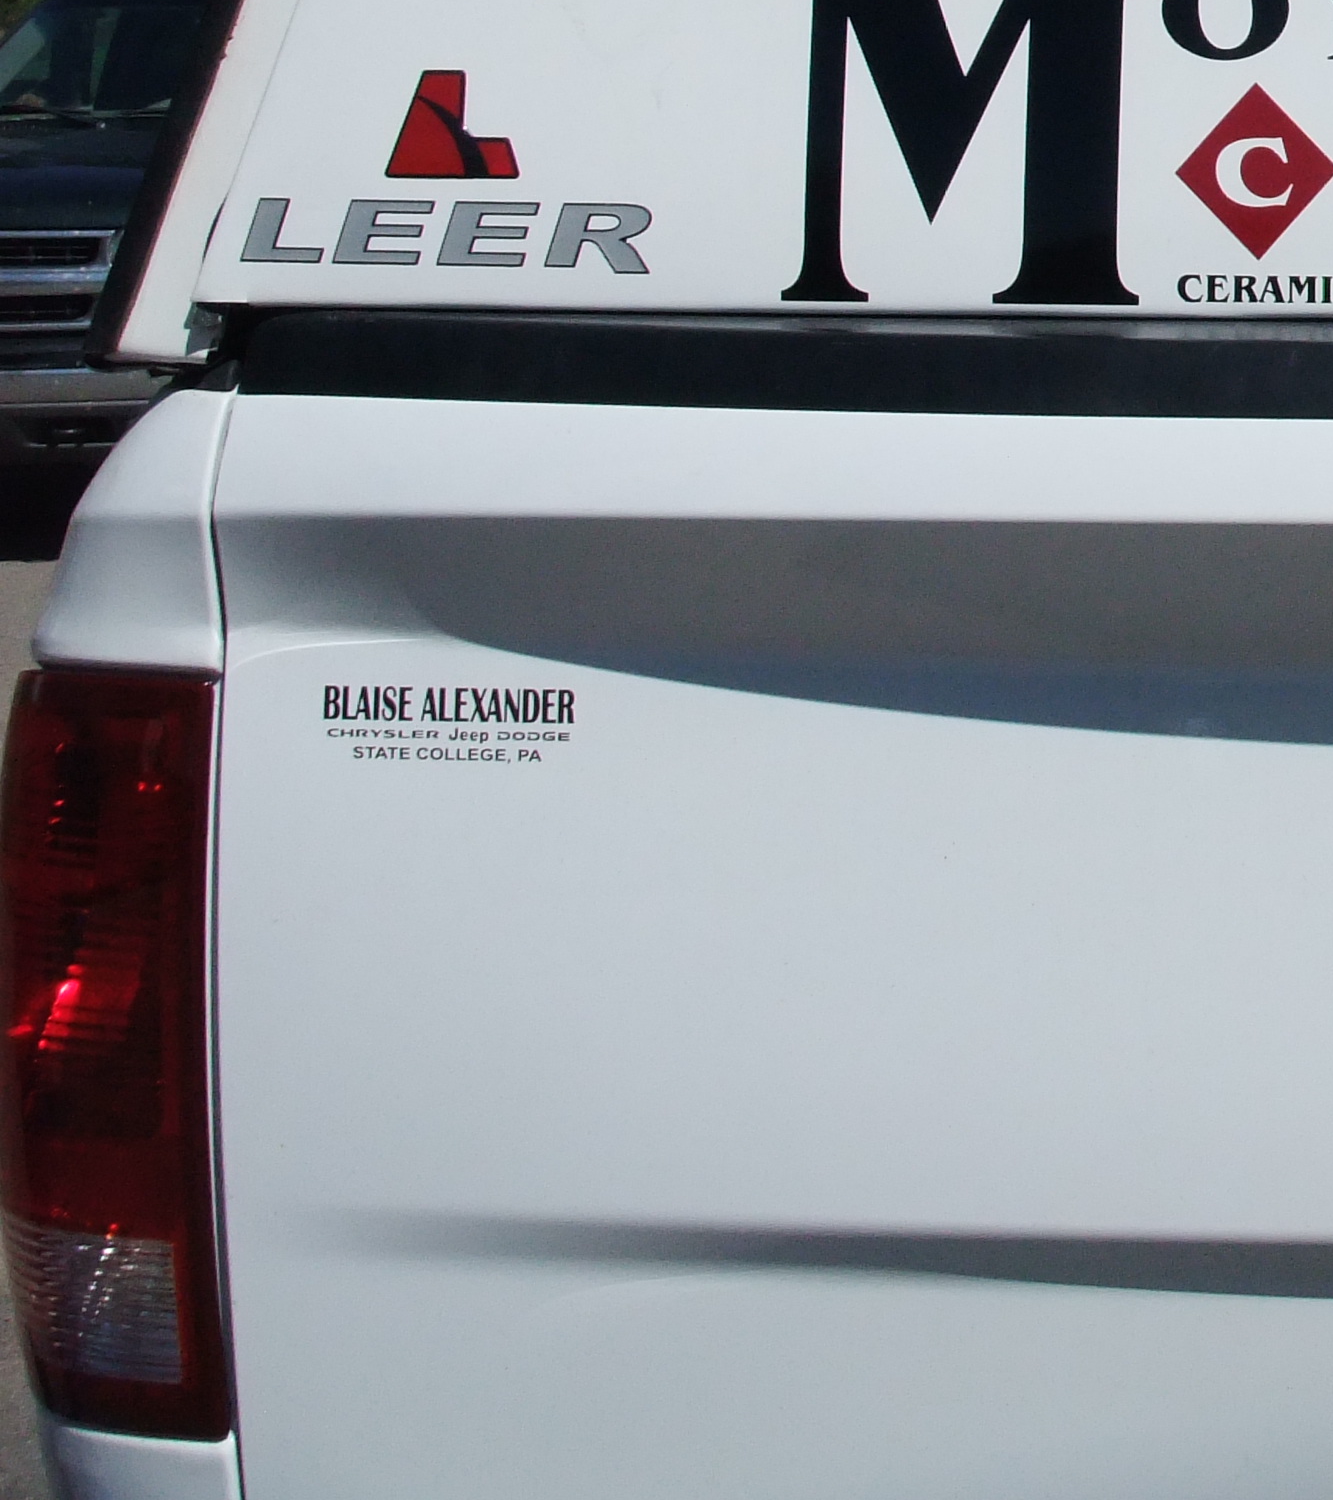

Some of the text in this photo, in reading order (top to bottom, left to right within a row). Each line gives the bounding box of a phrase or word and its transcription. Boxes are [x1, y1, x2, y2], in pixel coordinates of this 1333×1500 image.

[1215, 136, 1294, 208] C
[239, 196, 653, 276] LEER
[323, 684, 576, 725] BLAISE ALEXANDER
[326, 727, 571, 744] CHRYSLER Jeep DODGE
[352, 745, 543, 764] STATE COLLEGE, PA
